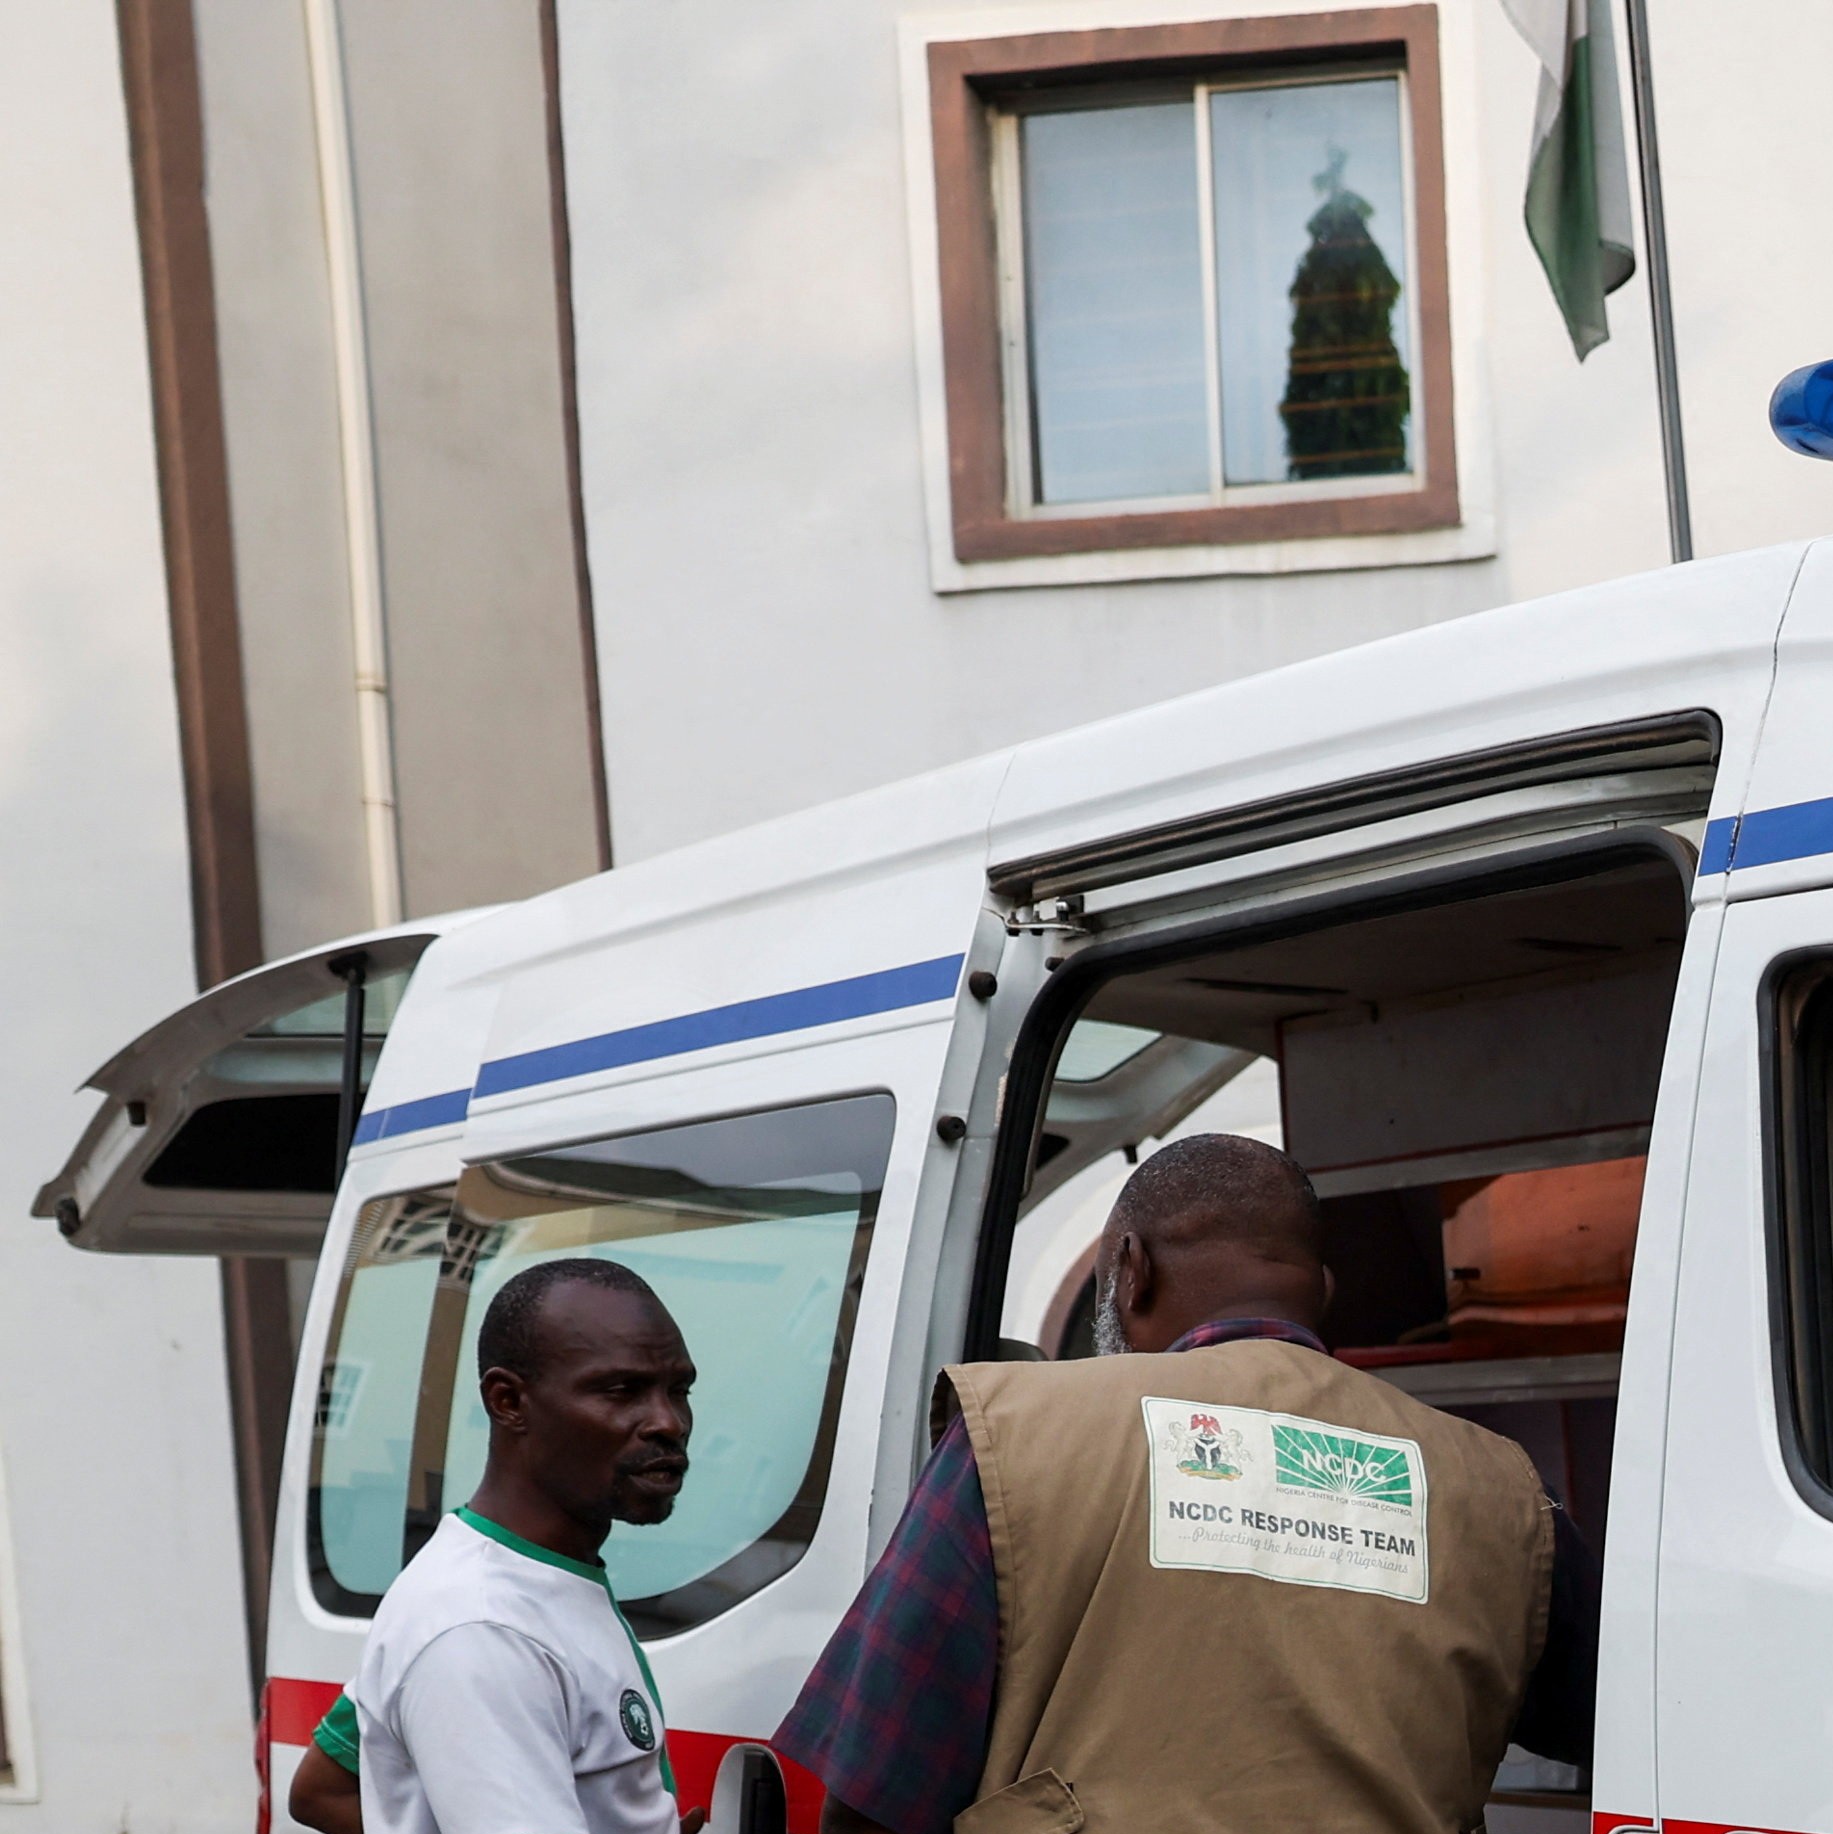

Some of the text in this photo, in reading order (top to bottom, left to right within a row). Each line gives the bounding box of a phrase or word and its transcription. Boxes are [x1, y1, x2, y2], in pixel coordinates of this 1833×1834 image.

[1301, 1448, 1388, 1483] NCDC
[1276, 1487, 1306, 1497] NIGERIA
[1307, 1489, 1334, 1502] CENTRE
[1350, 1498, 1380, 1510] DISEASE
[1380, 1503, 1413, 1517] CONTROL
[1168, 1500, 1416, 1557] NCDC RESPONSE TEAM
[1263, 1538, 1280, 1553] the
[1284, 1541, 1326, 1559] health
[1329, 1545, 1344, 1564] of
[1346, 1550, 1409, 1574] Nigerians
